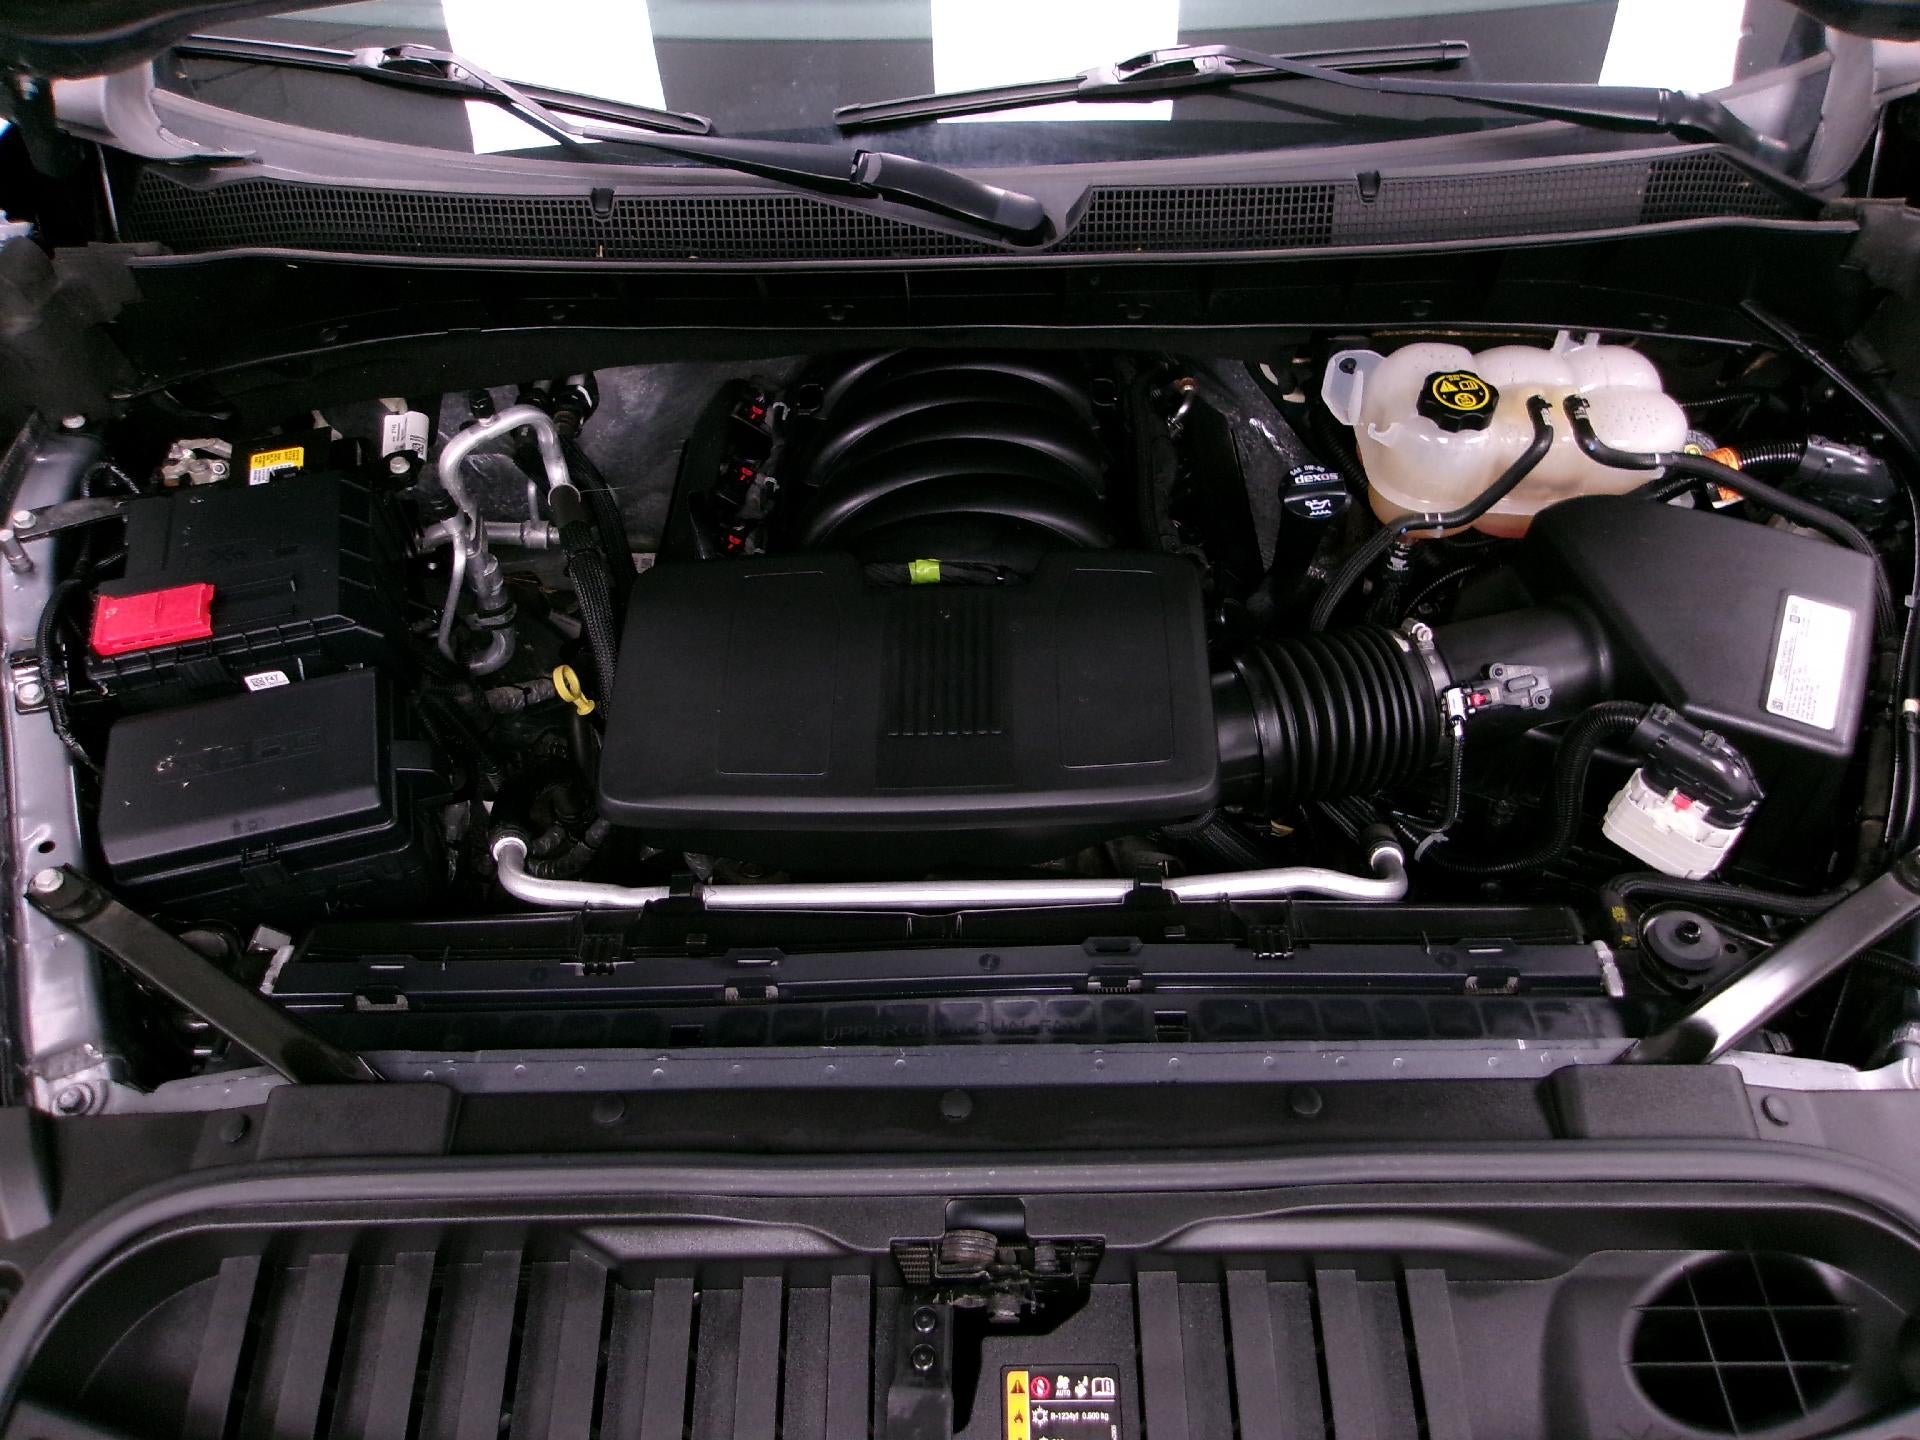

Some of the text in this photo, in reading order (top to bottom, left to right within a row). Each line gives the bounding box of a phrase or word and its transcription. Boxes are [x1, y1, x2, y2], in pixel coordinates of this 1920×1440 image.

[1289, 466, 1302, 476] SAE
[1294, 472, 1339, 484] dexos
[823, 1022, 899, 1040] UPPER
